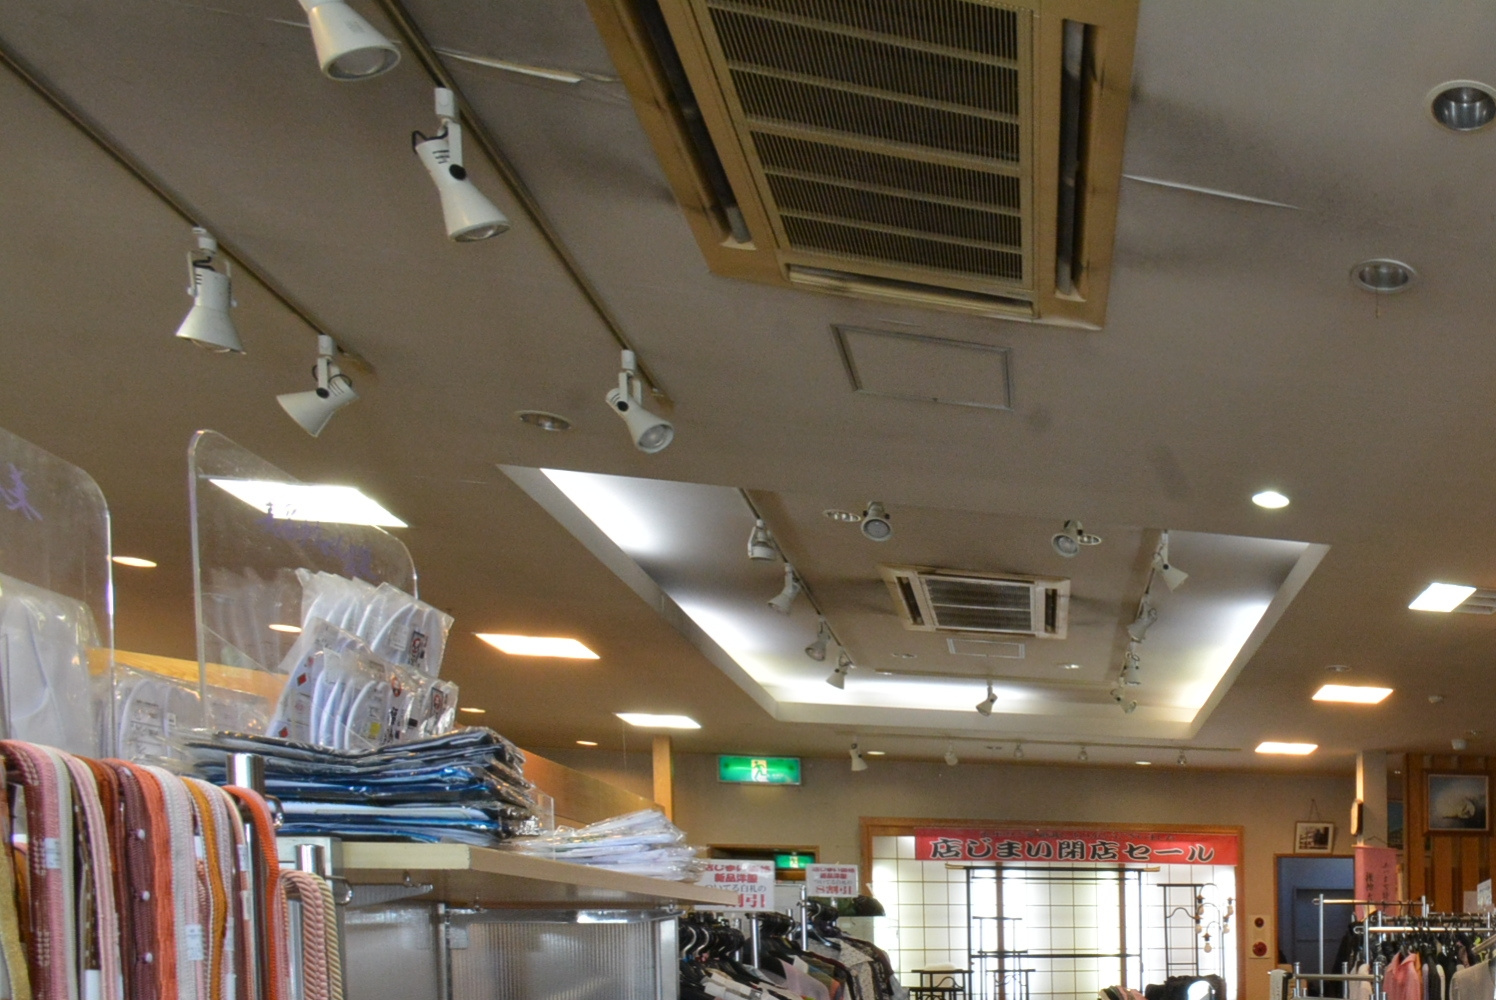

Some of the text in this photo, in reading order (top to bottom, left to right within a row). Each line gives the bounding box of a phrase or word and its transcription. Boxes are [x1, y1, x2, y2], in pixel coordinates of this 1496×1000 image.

[929, 836, 1215, 863] 店じまい閉店セール
